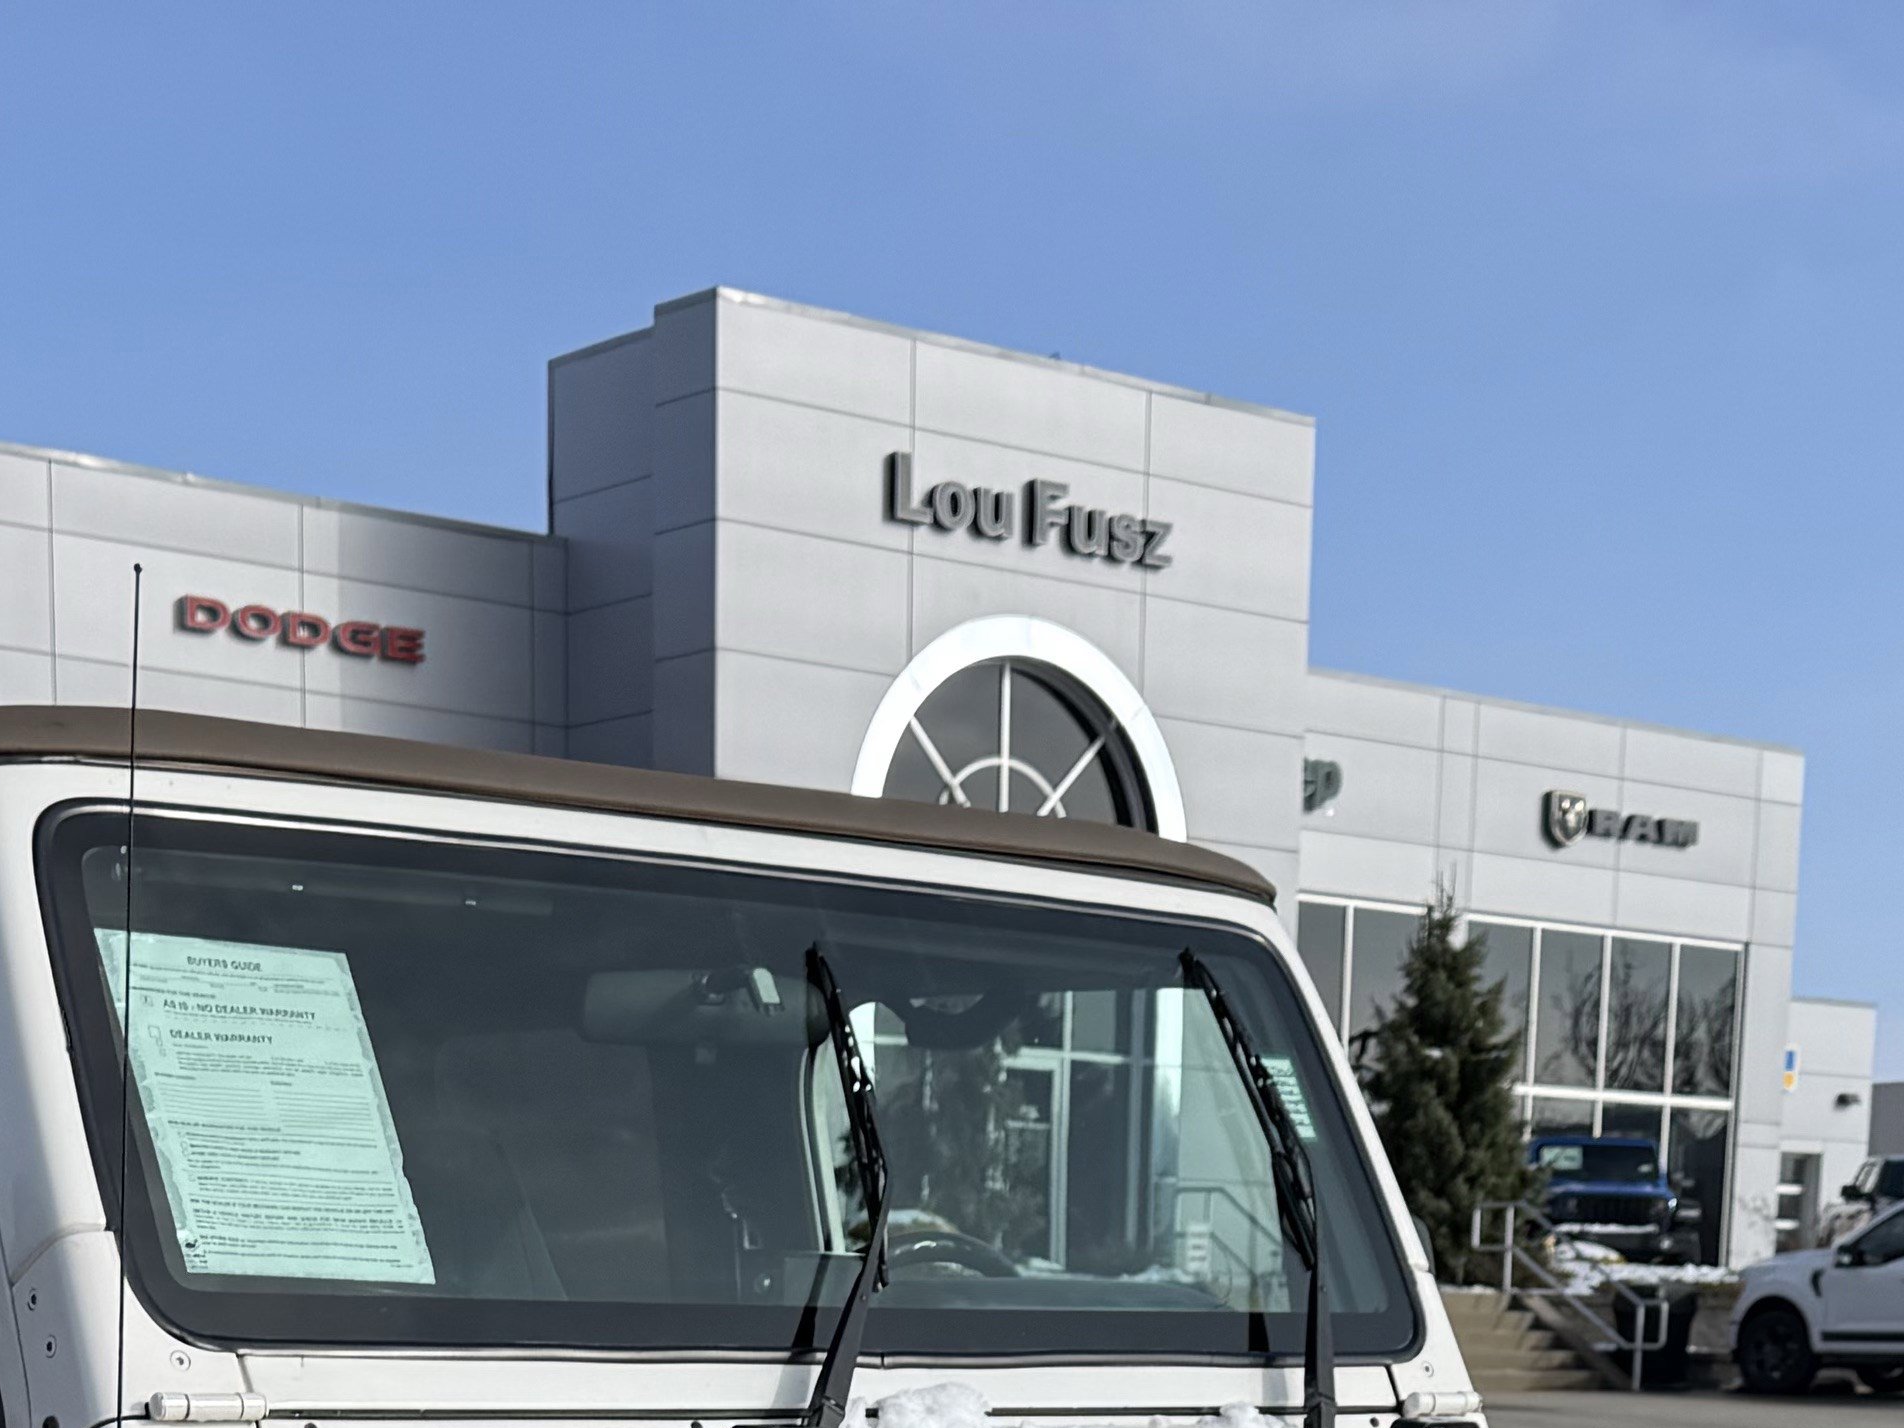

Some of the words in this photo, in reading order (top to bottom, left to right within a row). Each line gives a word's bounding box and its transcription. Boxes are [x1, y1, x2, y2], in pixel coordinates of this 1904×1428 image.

[883, 450, 1014, 540] Lou
[1022, 478, 1173, 570] Fusz
[175, 593, 425, 664] DODGE
[1587, 808, 1700, 849] RAM
[187, 956, 229, 969] BUYERS
[215, 1004, 259, 1015] DEALER
[170, 1029, 213, 1041] DEALER
